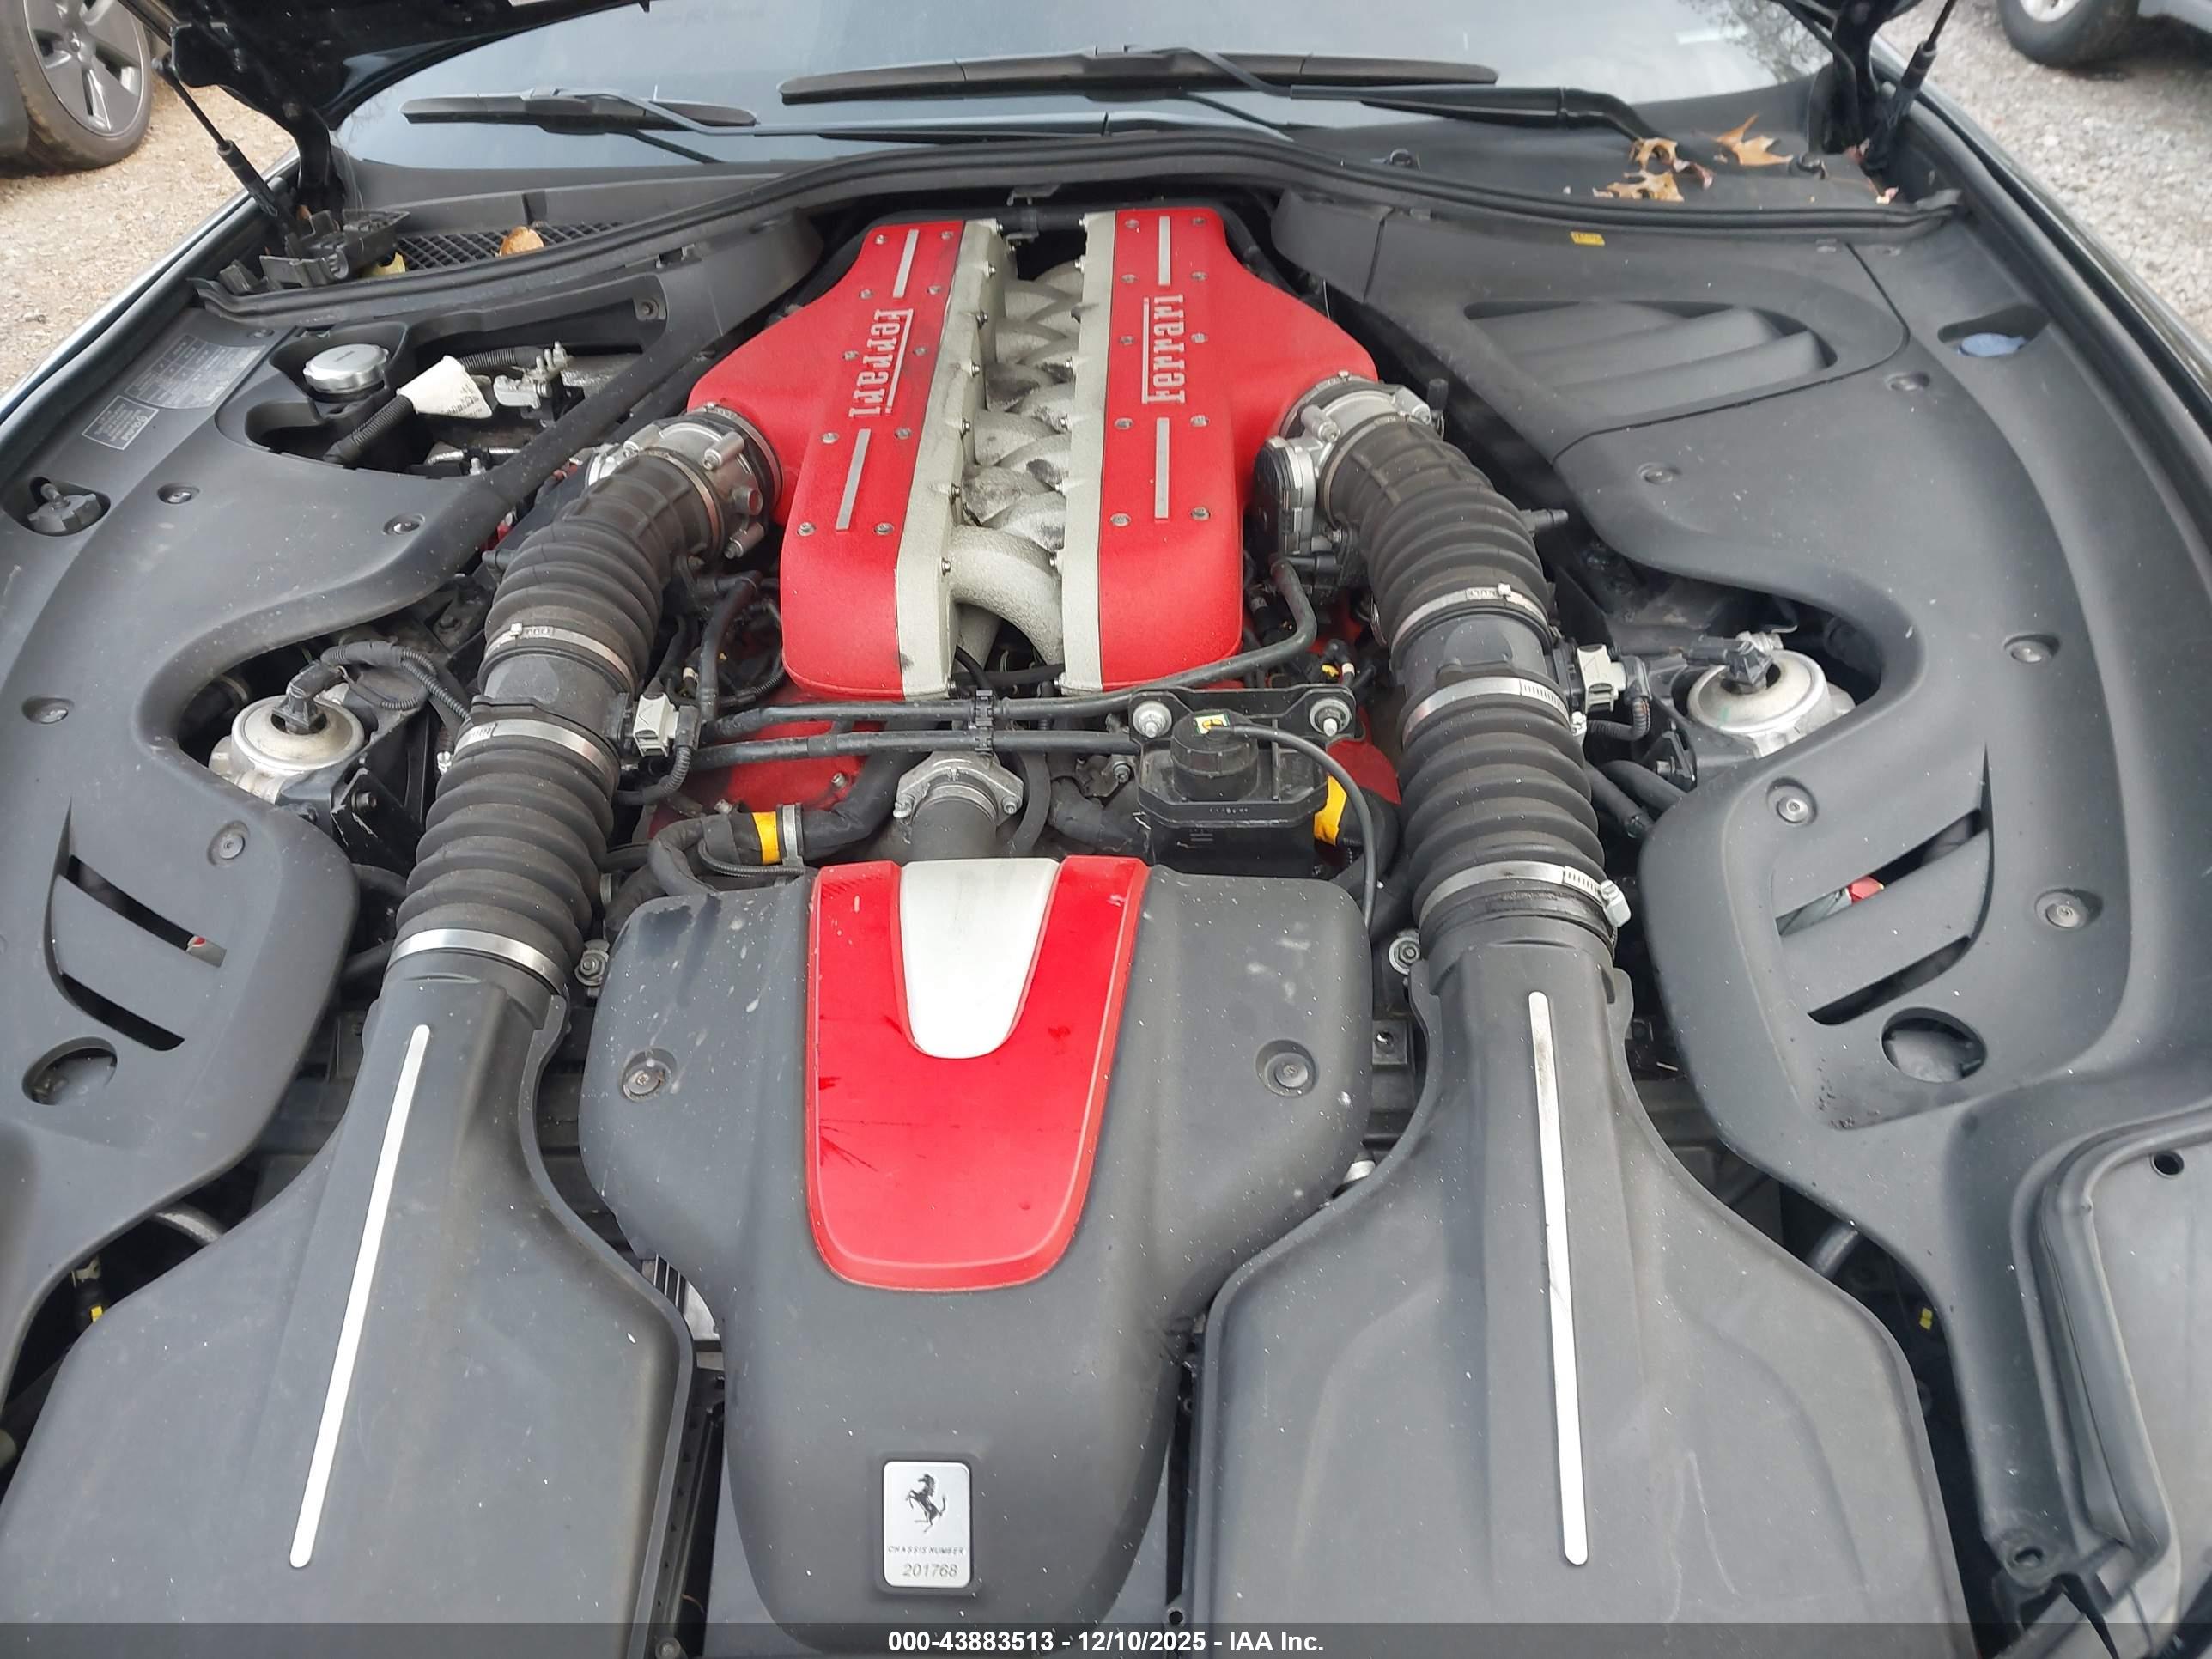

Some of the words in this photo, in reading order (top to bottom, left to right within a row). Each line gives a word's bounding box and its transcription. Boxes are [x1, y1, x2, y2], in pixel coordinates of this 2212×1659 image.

[848, 308, 914, 418] Ferrari
[1141, 294, 1186, 404] Ferrari
[887, 1545, 927, 1553] CHASSIS
[928, 1545, 964, 1555] NUMBER
[902, 1563, 958, 1577] 201768
